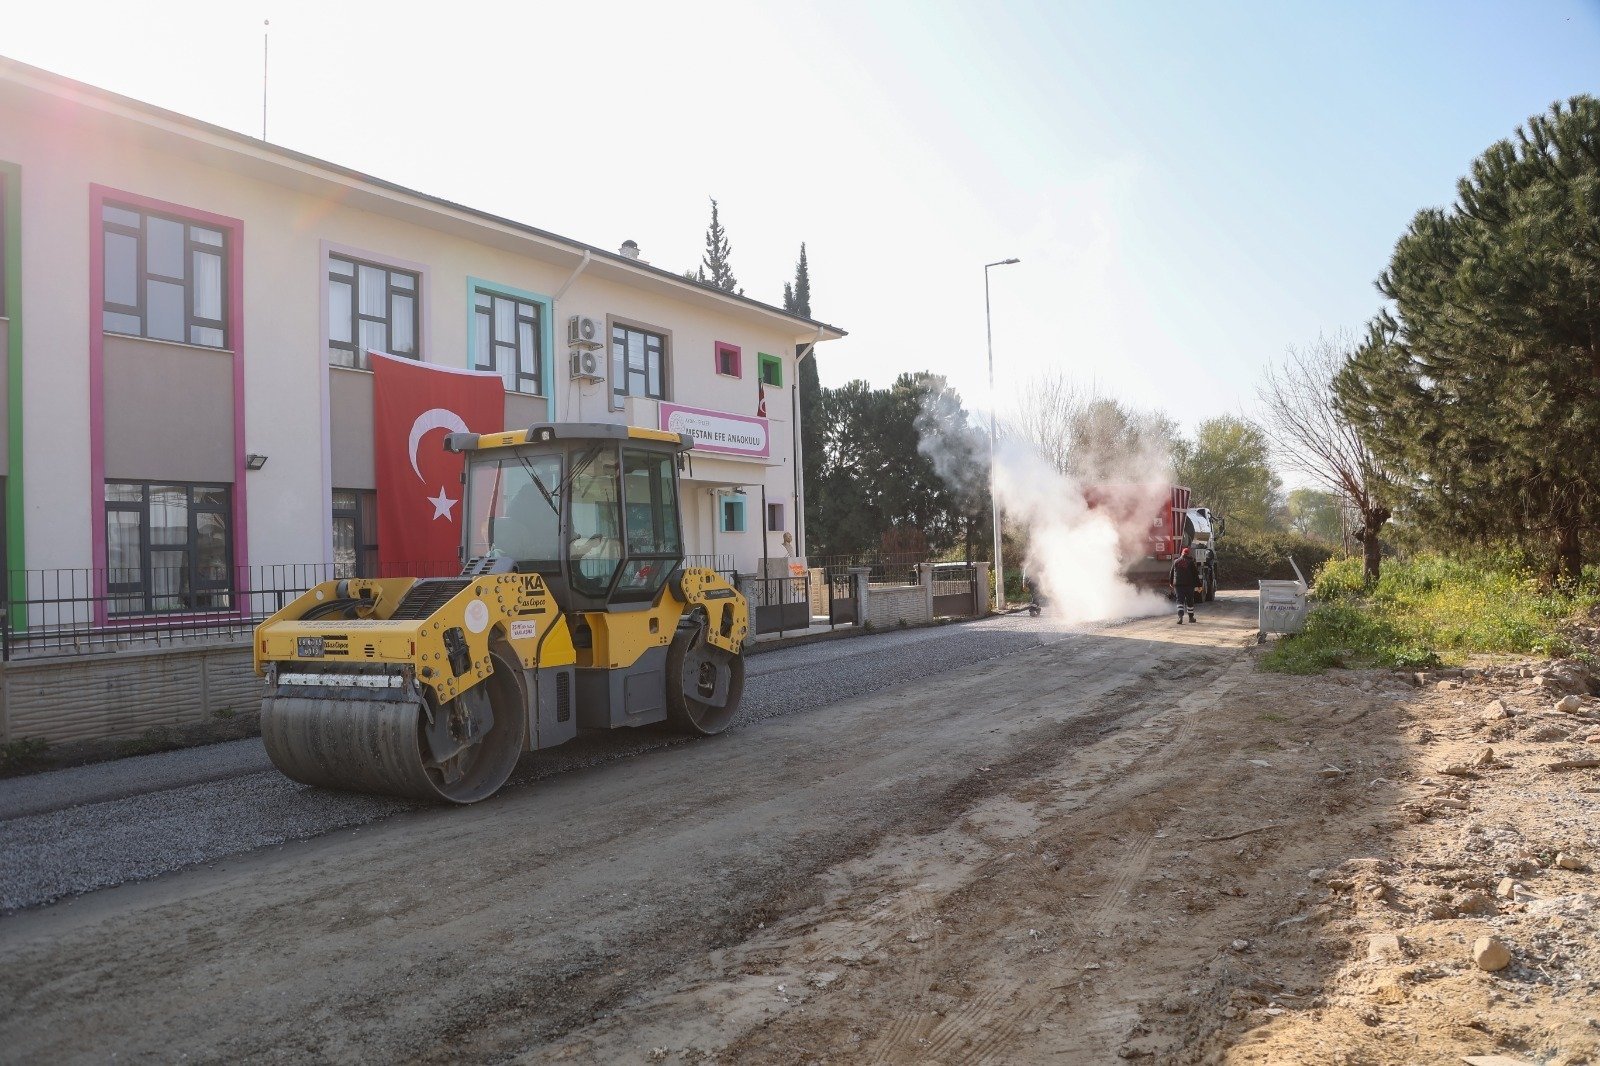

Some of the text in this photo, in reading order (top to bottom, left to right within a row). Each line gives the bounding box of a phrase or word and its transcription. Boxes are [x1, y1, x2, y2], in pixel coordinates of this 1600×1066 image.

[685, 428, 760, 446] MESTAN EFE ANAOKULU
